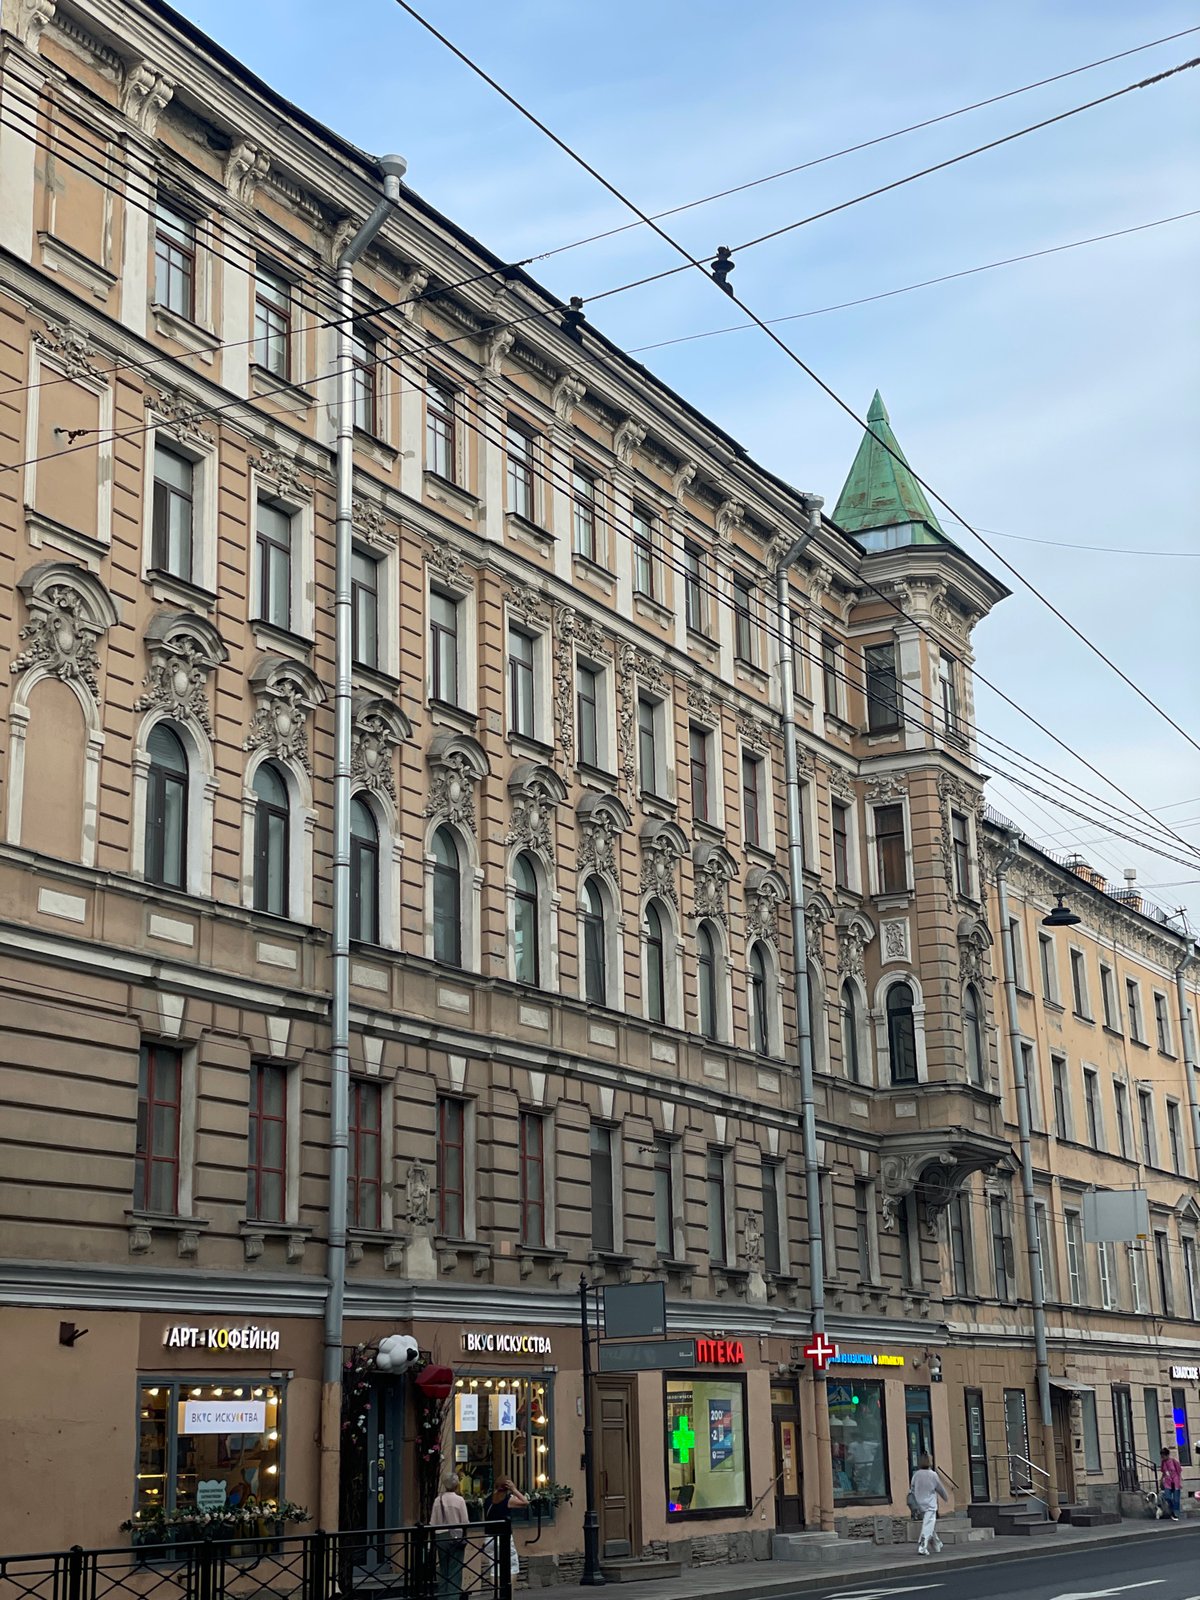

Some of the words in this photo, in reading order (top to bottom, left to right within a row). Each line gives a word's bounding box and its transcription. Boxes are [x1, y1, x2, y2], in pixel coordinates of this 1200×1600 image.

[467, 1333, 494, 1351] ВКУС
[496, 1334, 552, 1354] ИСКУССТВА
[697, 1338, 745, 1363] ПТЕКА
